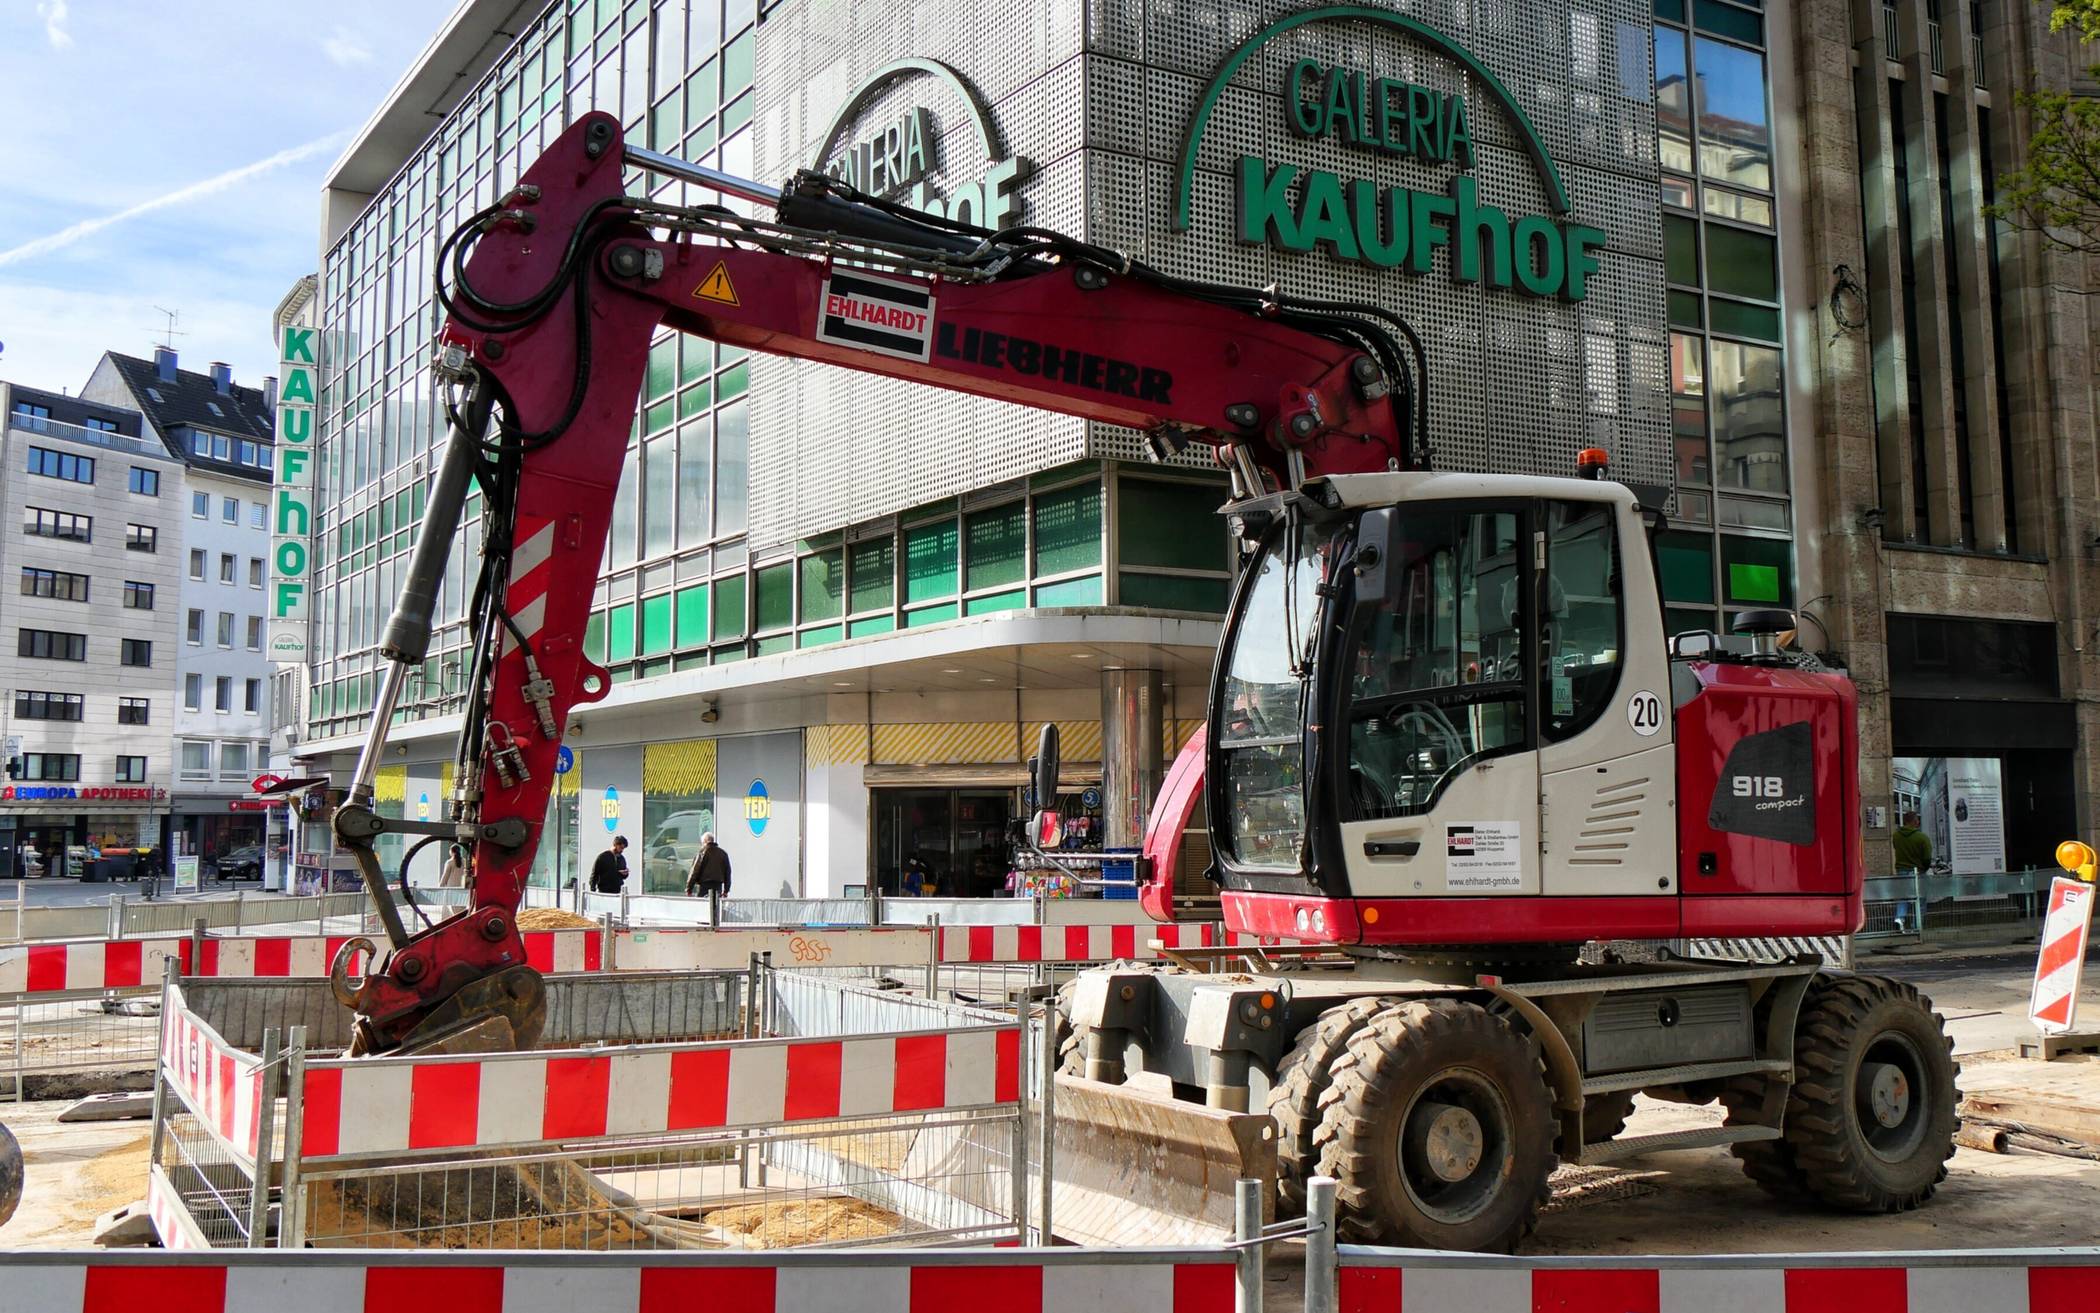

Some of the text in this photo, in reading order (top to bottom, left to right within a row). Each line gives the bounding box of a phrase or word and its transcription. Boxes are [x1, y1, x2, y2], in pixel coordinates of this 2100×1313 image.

[1288, 57, 1475, 168] GALERIA
[826, 295, 927, 333] EHLHARDT
[936, 320, 1174, 406] LIEBHERR
[1634, 697, 1659, 727] 20
[16, 786, 77, 800] EUROPA
[1733, 776, 1783, 797] 918
[601, 799, 621, 819] TEDi
[744, 796, 771, 819] TEDi
[1755, 794, 1805, 811] compact
[1448, 837, 1474, 845] EHLHARDT
[1448, 876, 1520, 887] www.ehlhardt-gmbh.de
